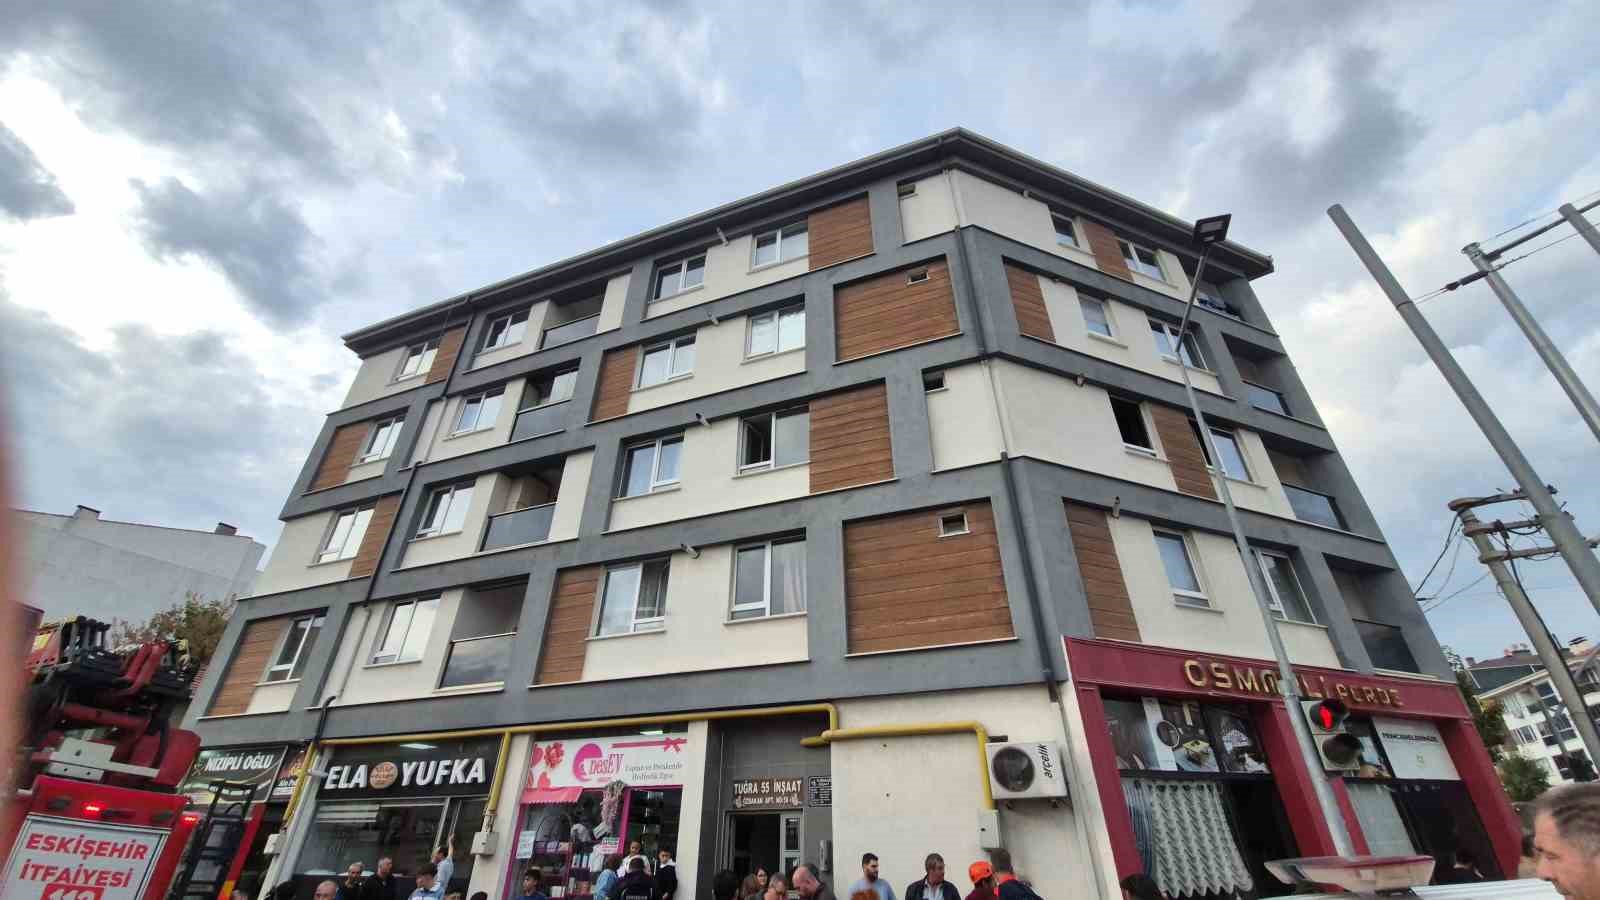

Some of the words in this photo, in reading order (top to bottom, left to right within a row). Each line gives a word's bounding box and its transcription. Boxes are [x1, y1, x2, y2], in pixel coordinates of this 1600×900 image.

[1184, 659, 1330, 700] OSMALİ
[243, 751, 274, 770] OĞLU
[324, 764, 369, 790] ELA
[401, 757, 487, 787] YUFKA
[1036, 743, 1053, 779] arçelik
[734, 779, 759, 795] TUĞRA
[761, 781, 770, 793] 55
[773, 778, 802, 796] İNŞAAT
[25, 832, 150, 861] ESKİŞEHİR
[19, 858, 134, 888] İTFAİYESİ
